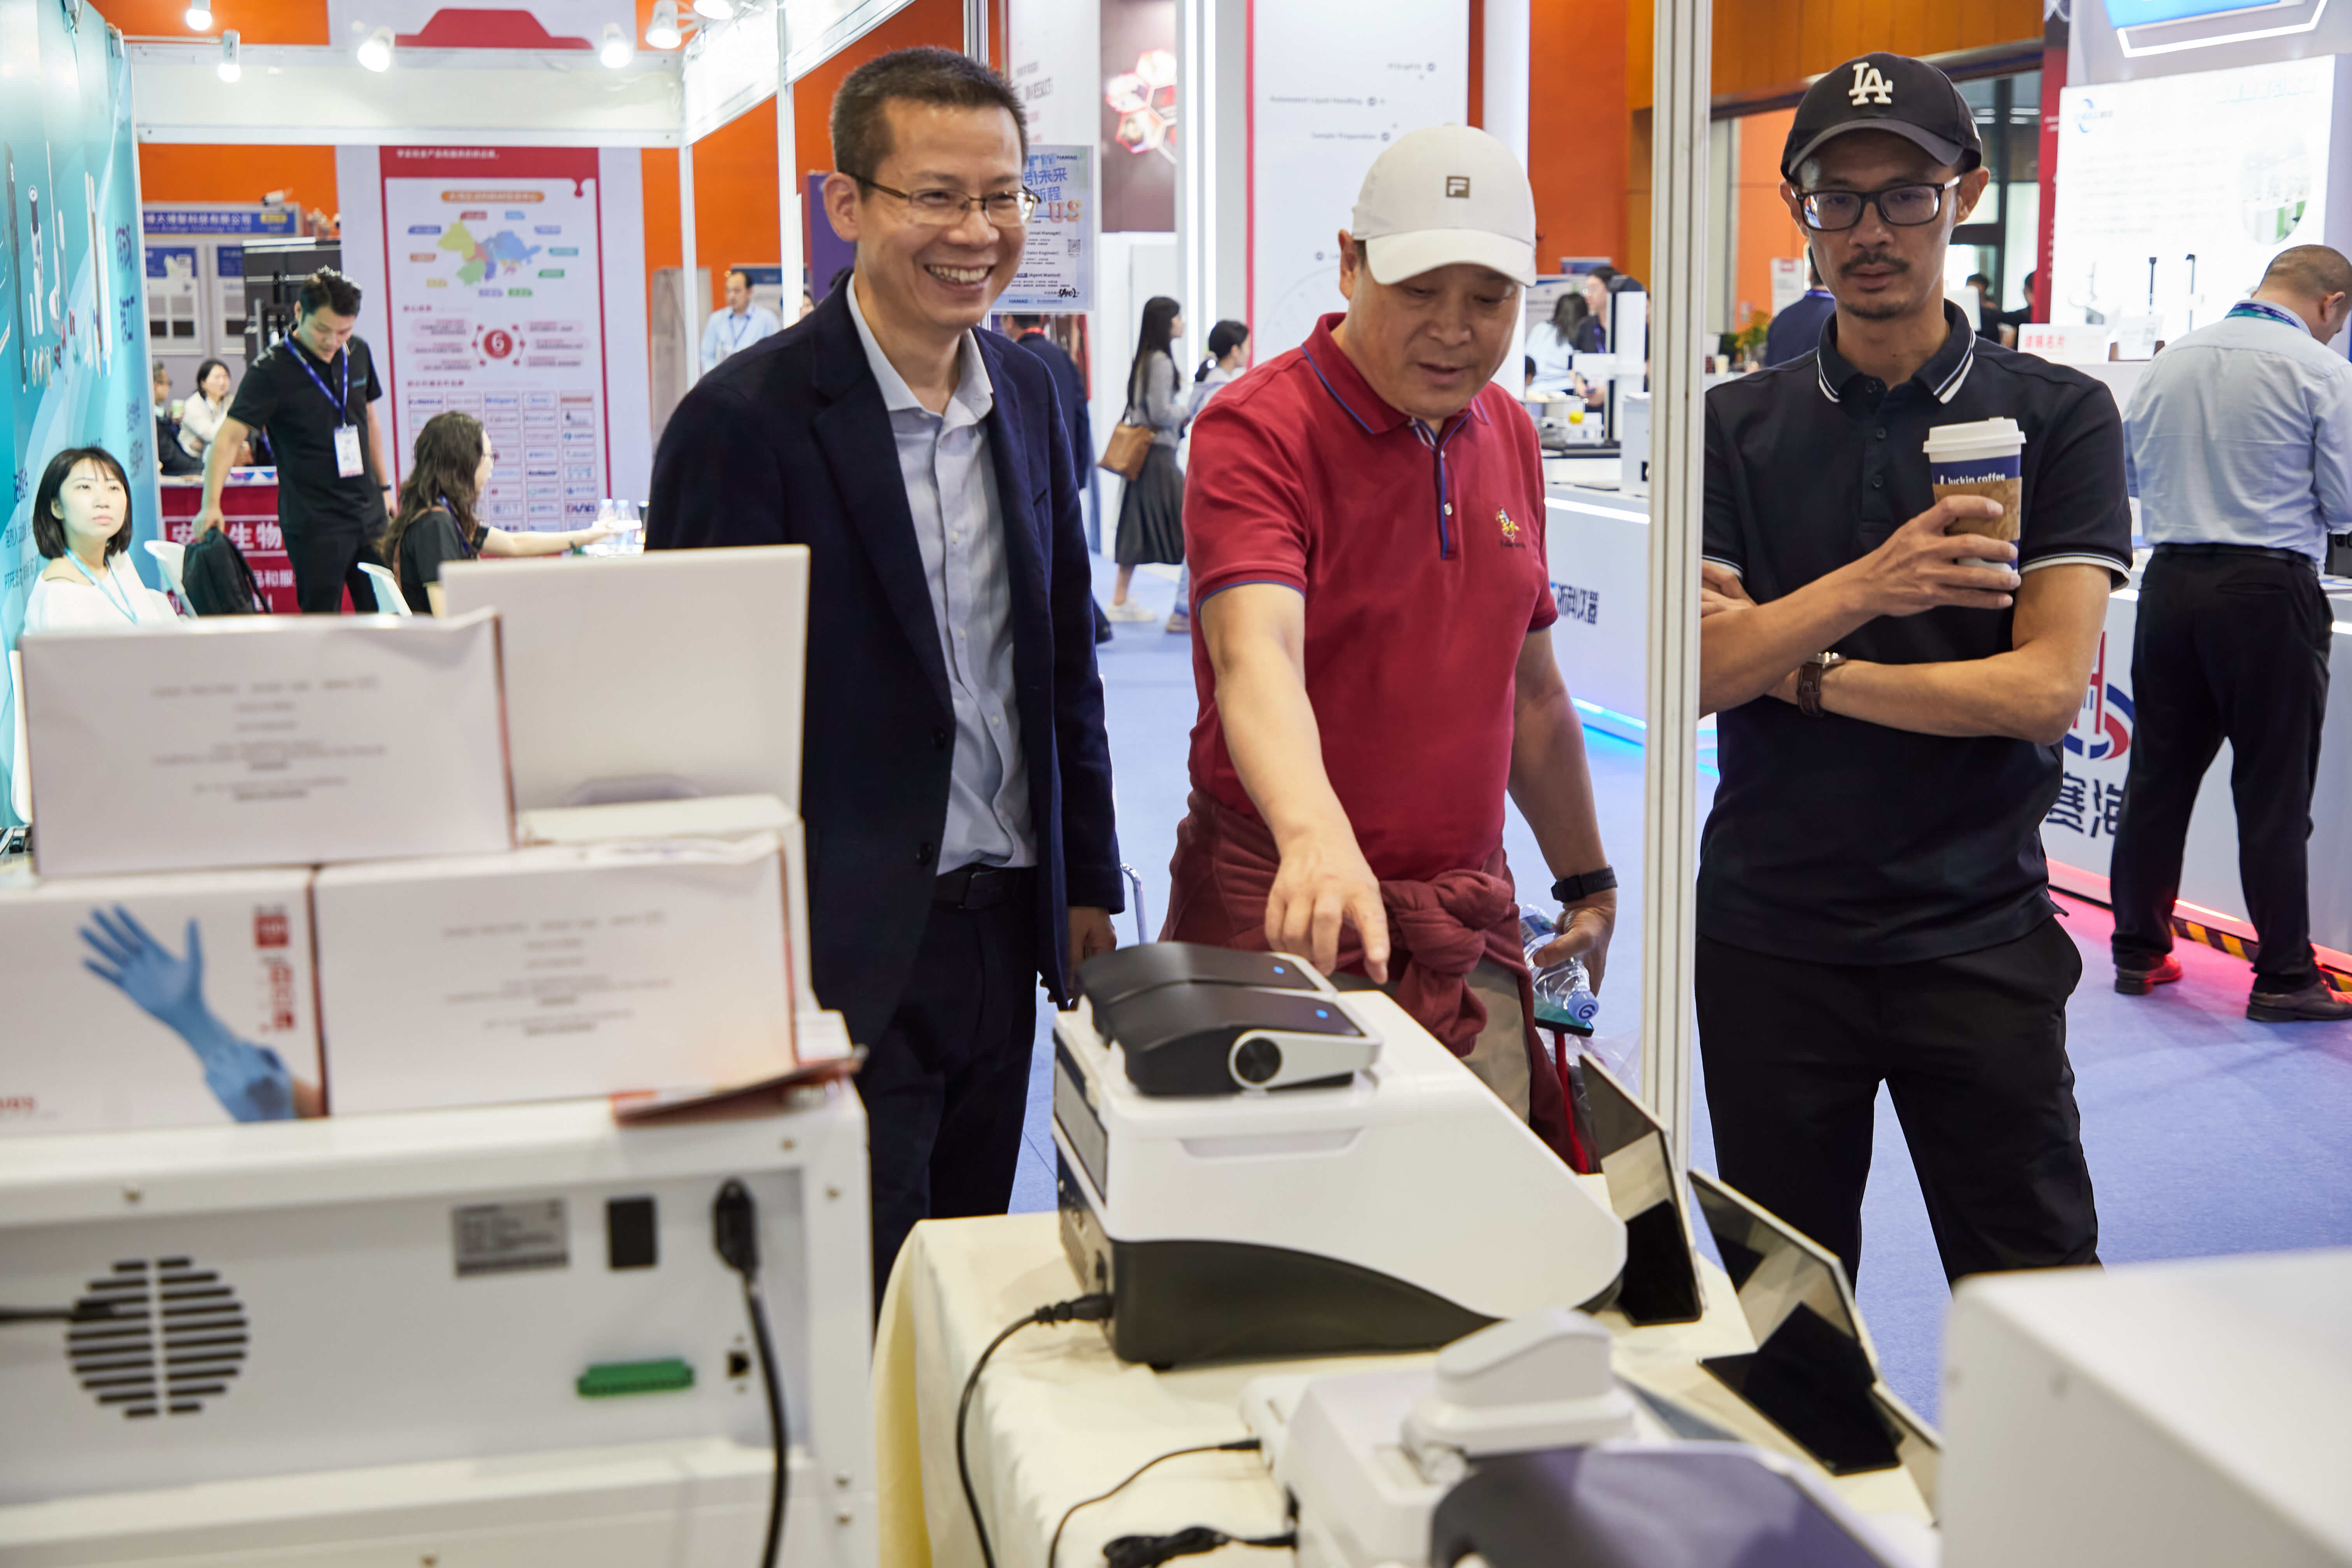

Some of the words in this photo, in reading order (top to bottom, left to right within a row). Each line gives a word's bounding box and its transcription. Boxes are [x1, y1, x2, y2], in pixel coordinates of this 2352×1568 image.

[1848, 61, 1893, 106] LA
[1049, 199, 1082, 223] US
[491, 333, 504, 351] 6
[1977, 472, 2006, 483] coffee
[172, 522, 283, 549] 安生物
